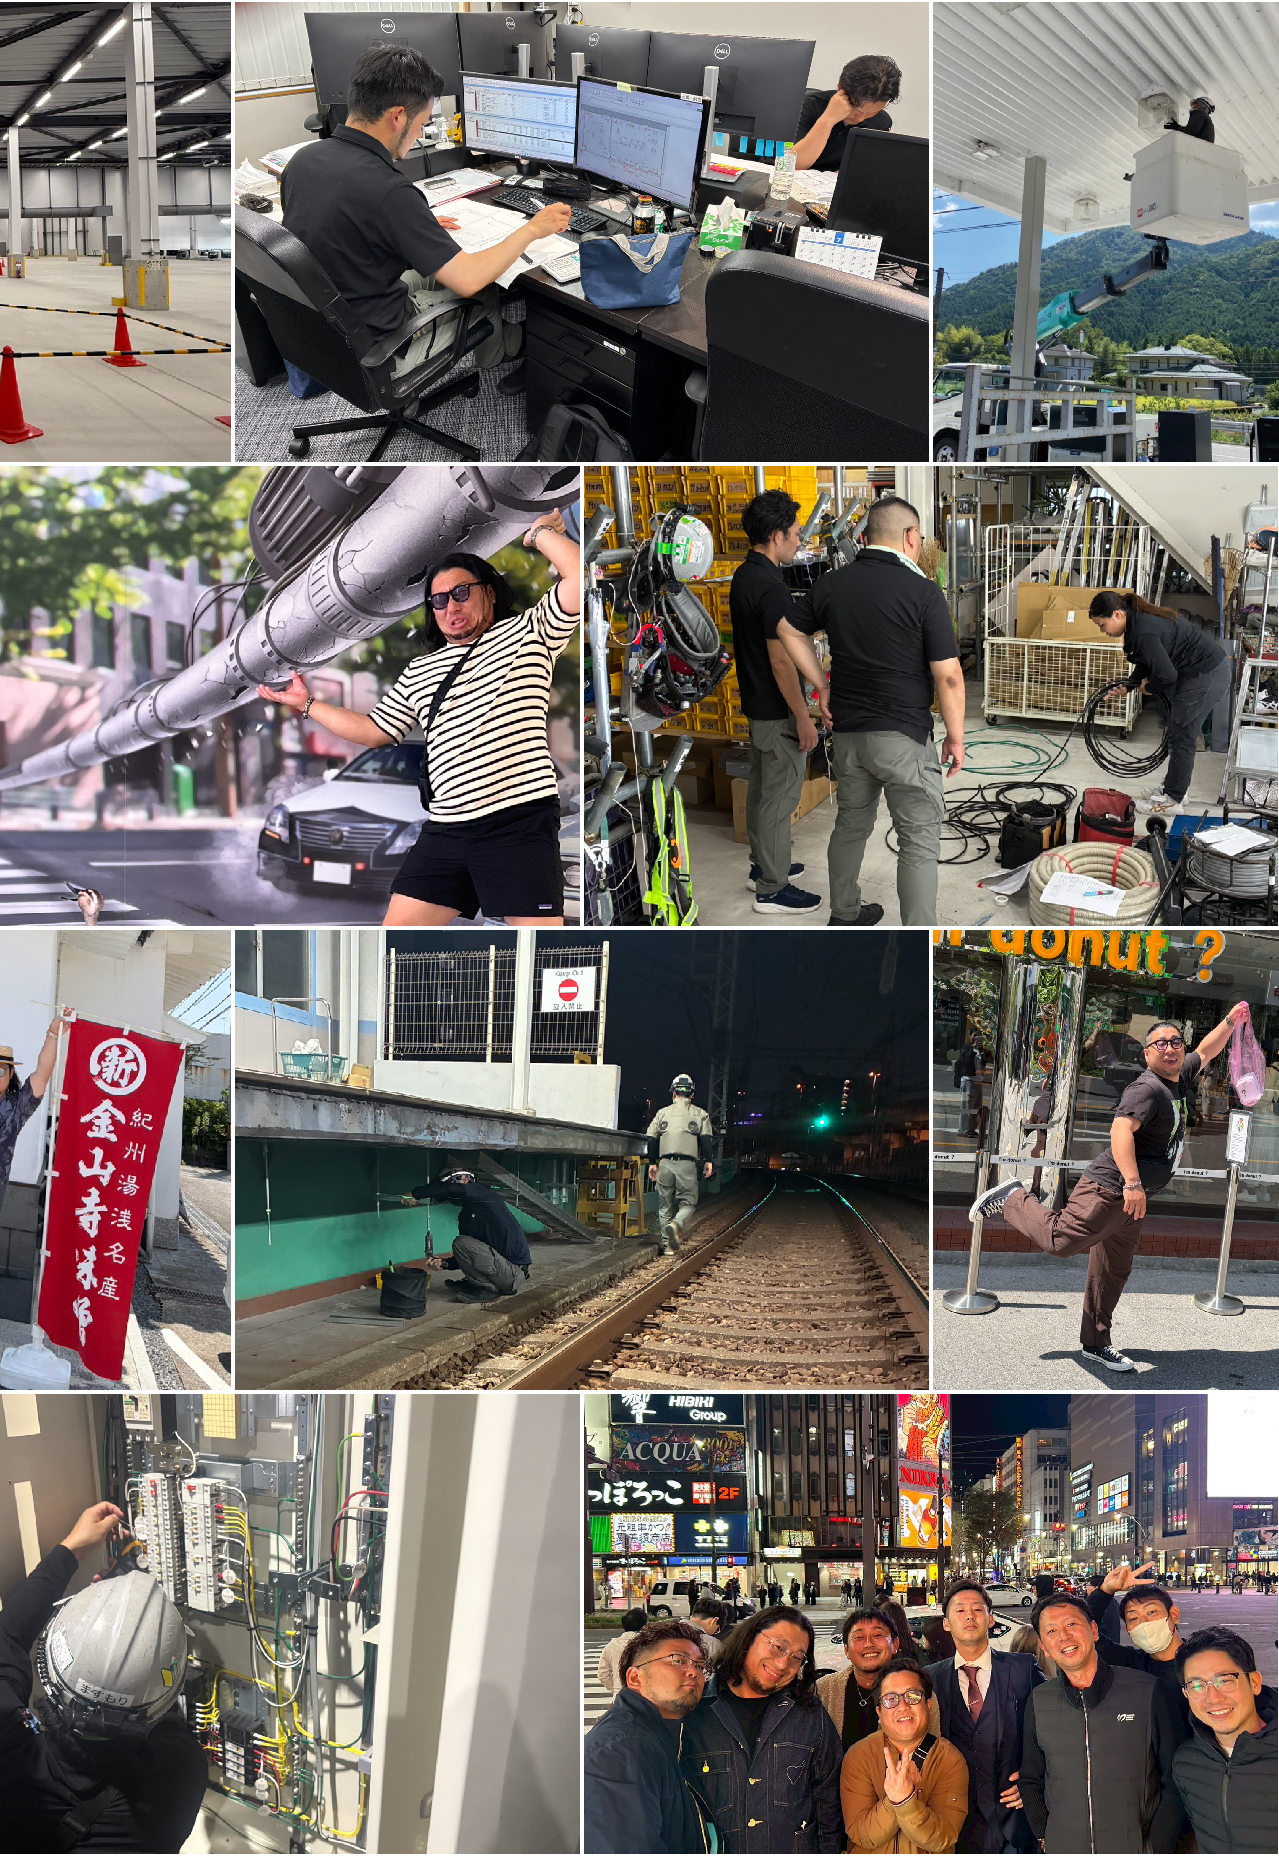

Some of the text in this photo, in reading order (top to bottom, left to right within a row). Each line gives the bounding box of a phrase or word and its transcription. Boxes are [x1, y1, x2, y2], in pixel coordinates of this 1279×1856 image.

[553, 1002, 583, 1011] 立入禁止
[97, 1107, 154, 1301] 紀州湯浅名産
[668, 1395, 715, 1408] HIBIKI
[689, 1409, 727, 1423] Group
[619, 1442, 702, 1465] ACQUA
[588, 1479, 684, 1507] っぽろっこ
[718, 1487, 740, 1500] 2F
[615, 1522, 664, 1533] 元祖串かつ
[80, 1684, 128, 1706] ますもり
